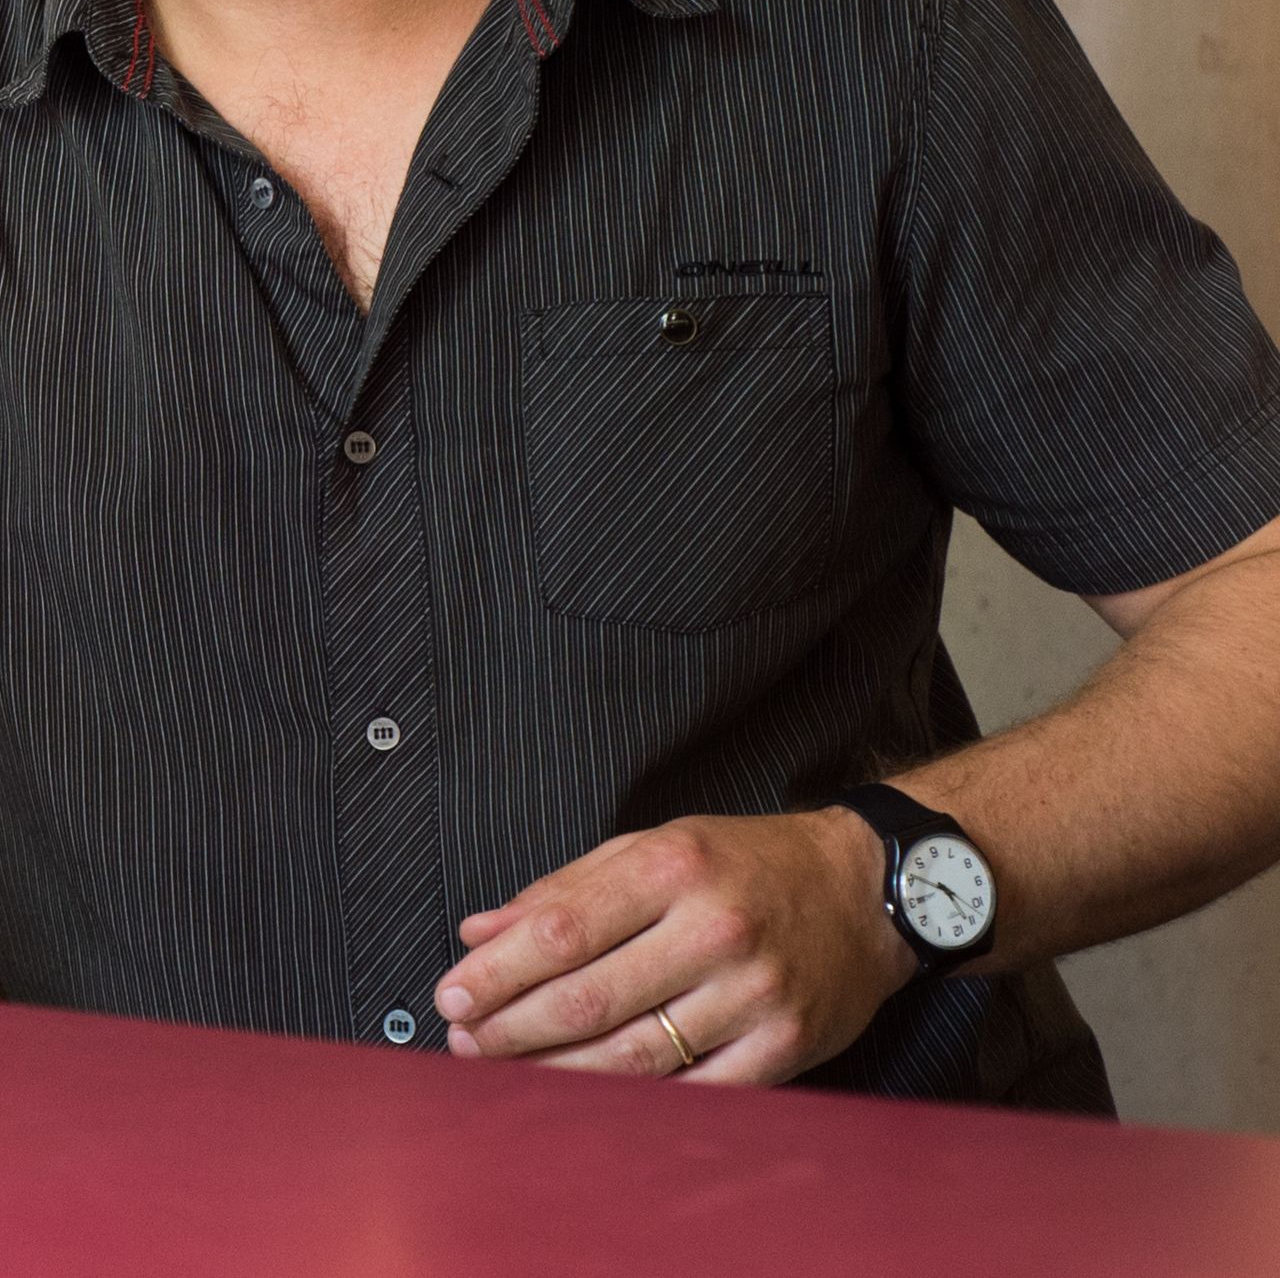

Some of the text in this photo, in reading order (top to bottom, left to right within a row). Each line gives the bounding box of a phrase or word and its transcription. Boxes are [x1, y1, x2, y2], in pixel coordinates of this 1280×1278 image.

[948, 848, 955, 859] 7
[915, 857, 925, 869] 5
[963, 857, 972, 869] 8
[908, 897, 917, 909] 3
[971, 896, 985, 909] 10
[918, 914, 927, 927] 2
